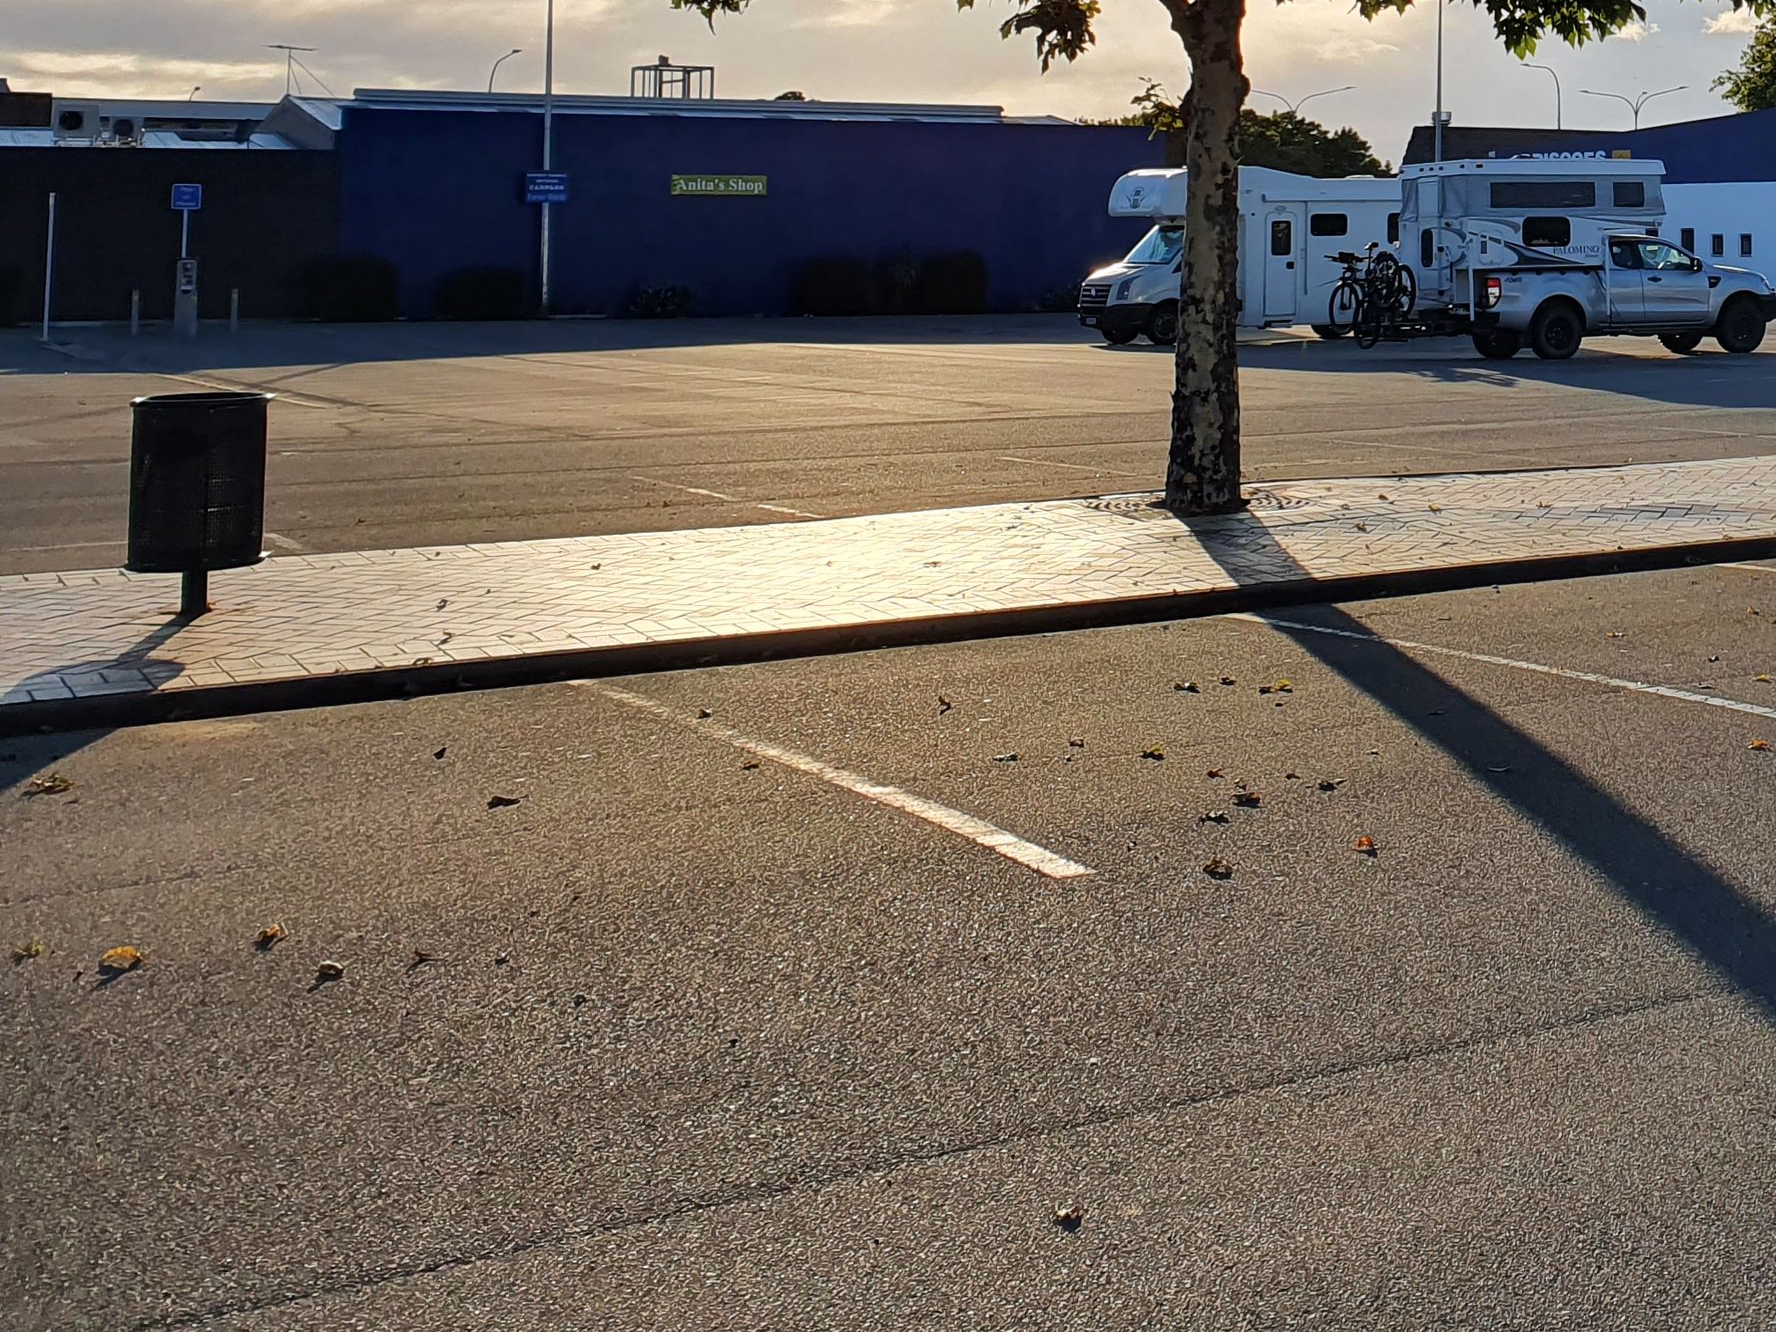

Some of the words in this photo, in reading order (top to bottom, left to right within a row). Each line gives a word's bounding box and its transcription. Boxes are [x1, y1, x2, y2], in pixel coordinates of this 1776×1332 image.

[678, 178, 725, 191] Anita's
[729, 178, 763, 194] Shop
[1553, 245, 1600, 255] PALOMINO
